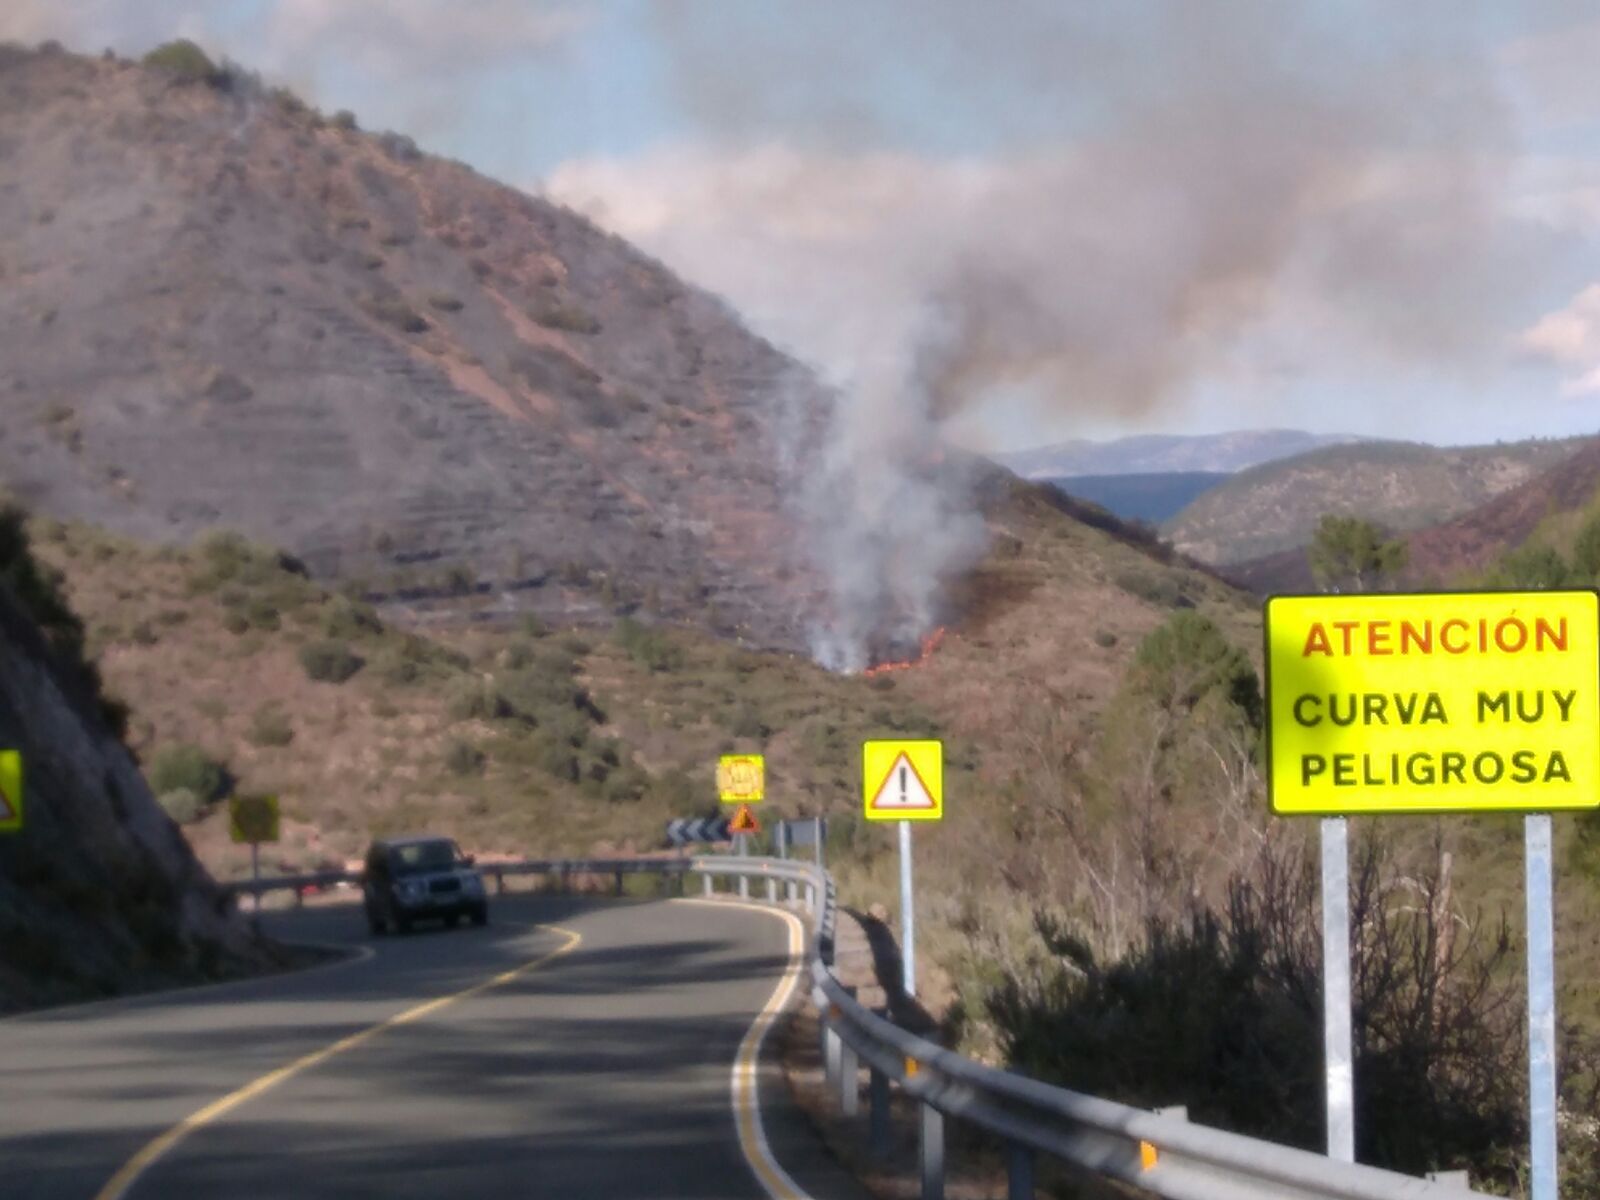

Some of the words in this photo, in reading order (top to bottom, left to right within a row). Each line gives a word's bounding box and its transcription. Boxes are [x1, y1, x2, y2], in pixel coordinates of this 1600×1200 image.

[1302, 609, 1569, 657] ATENCIÓN
[1293, 692, 1448, 727] CURVA
[1476, 690, 1577, 723] MUY
[1301, 750, 1572, 787] PELIGROSA
